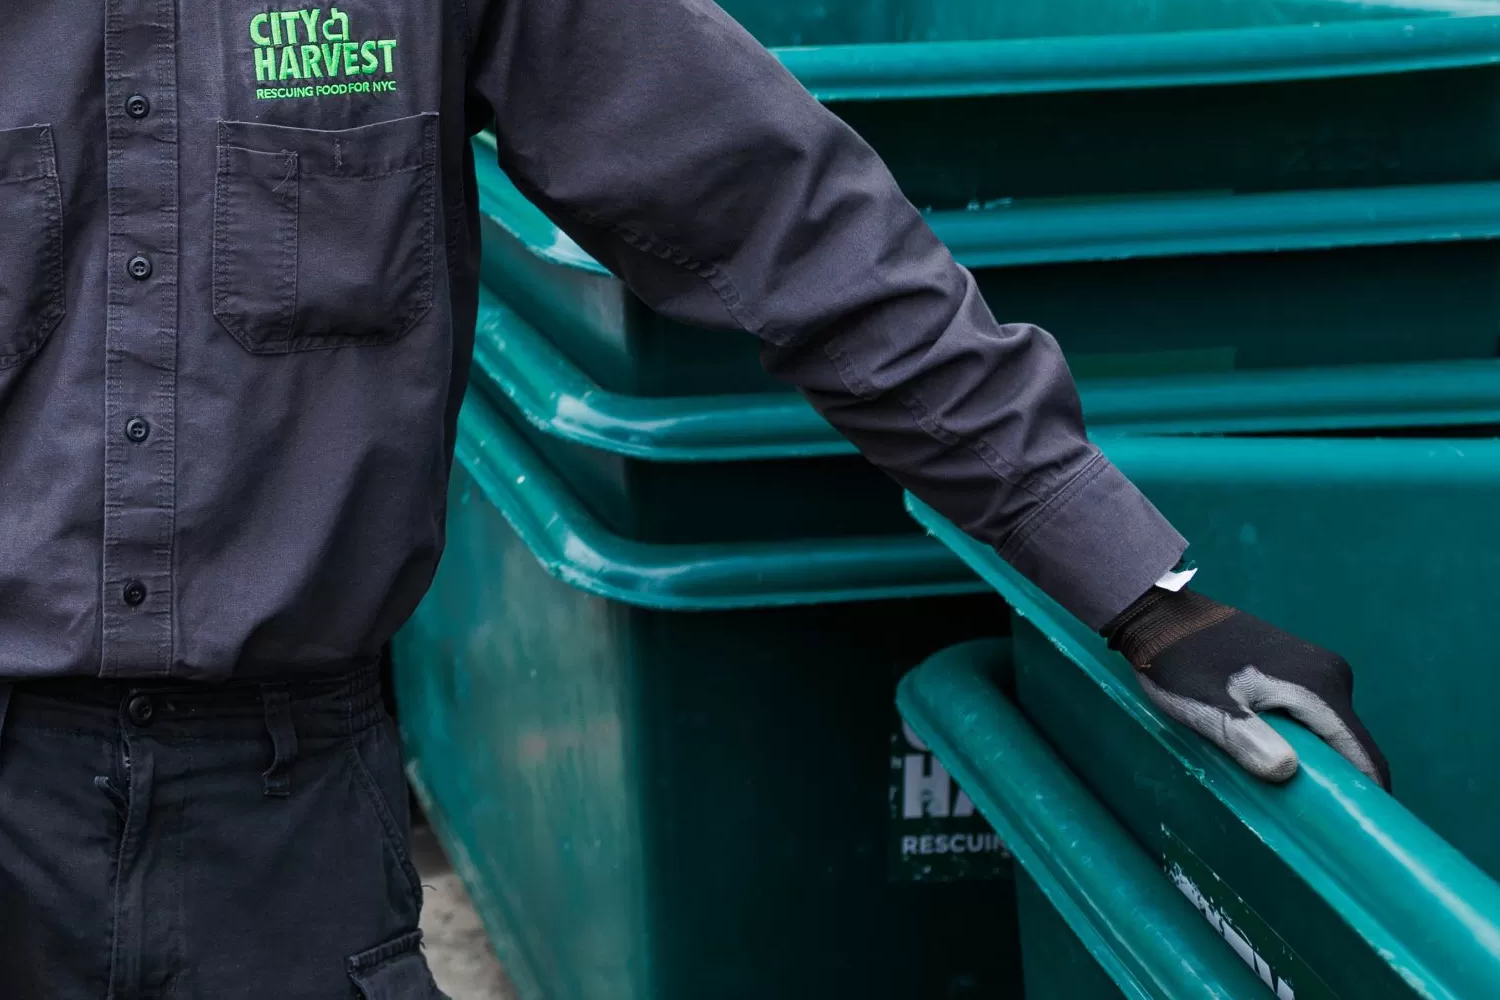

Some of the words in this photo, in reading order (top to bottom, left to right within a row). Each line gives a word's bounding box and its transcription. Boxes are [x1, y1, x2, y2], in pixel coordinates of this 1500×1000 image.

[250, 8, 321, 46] CITY
[253, 39, 397, 82] HARVEST
[256, 85, 314, 100] RESCUING
[316, 83, 347, 96] FOOD
[348, 81, 370, 94] FOR
[373, 80, 397, 92] NYC
